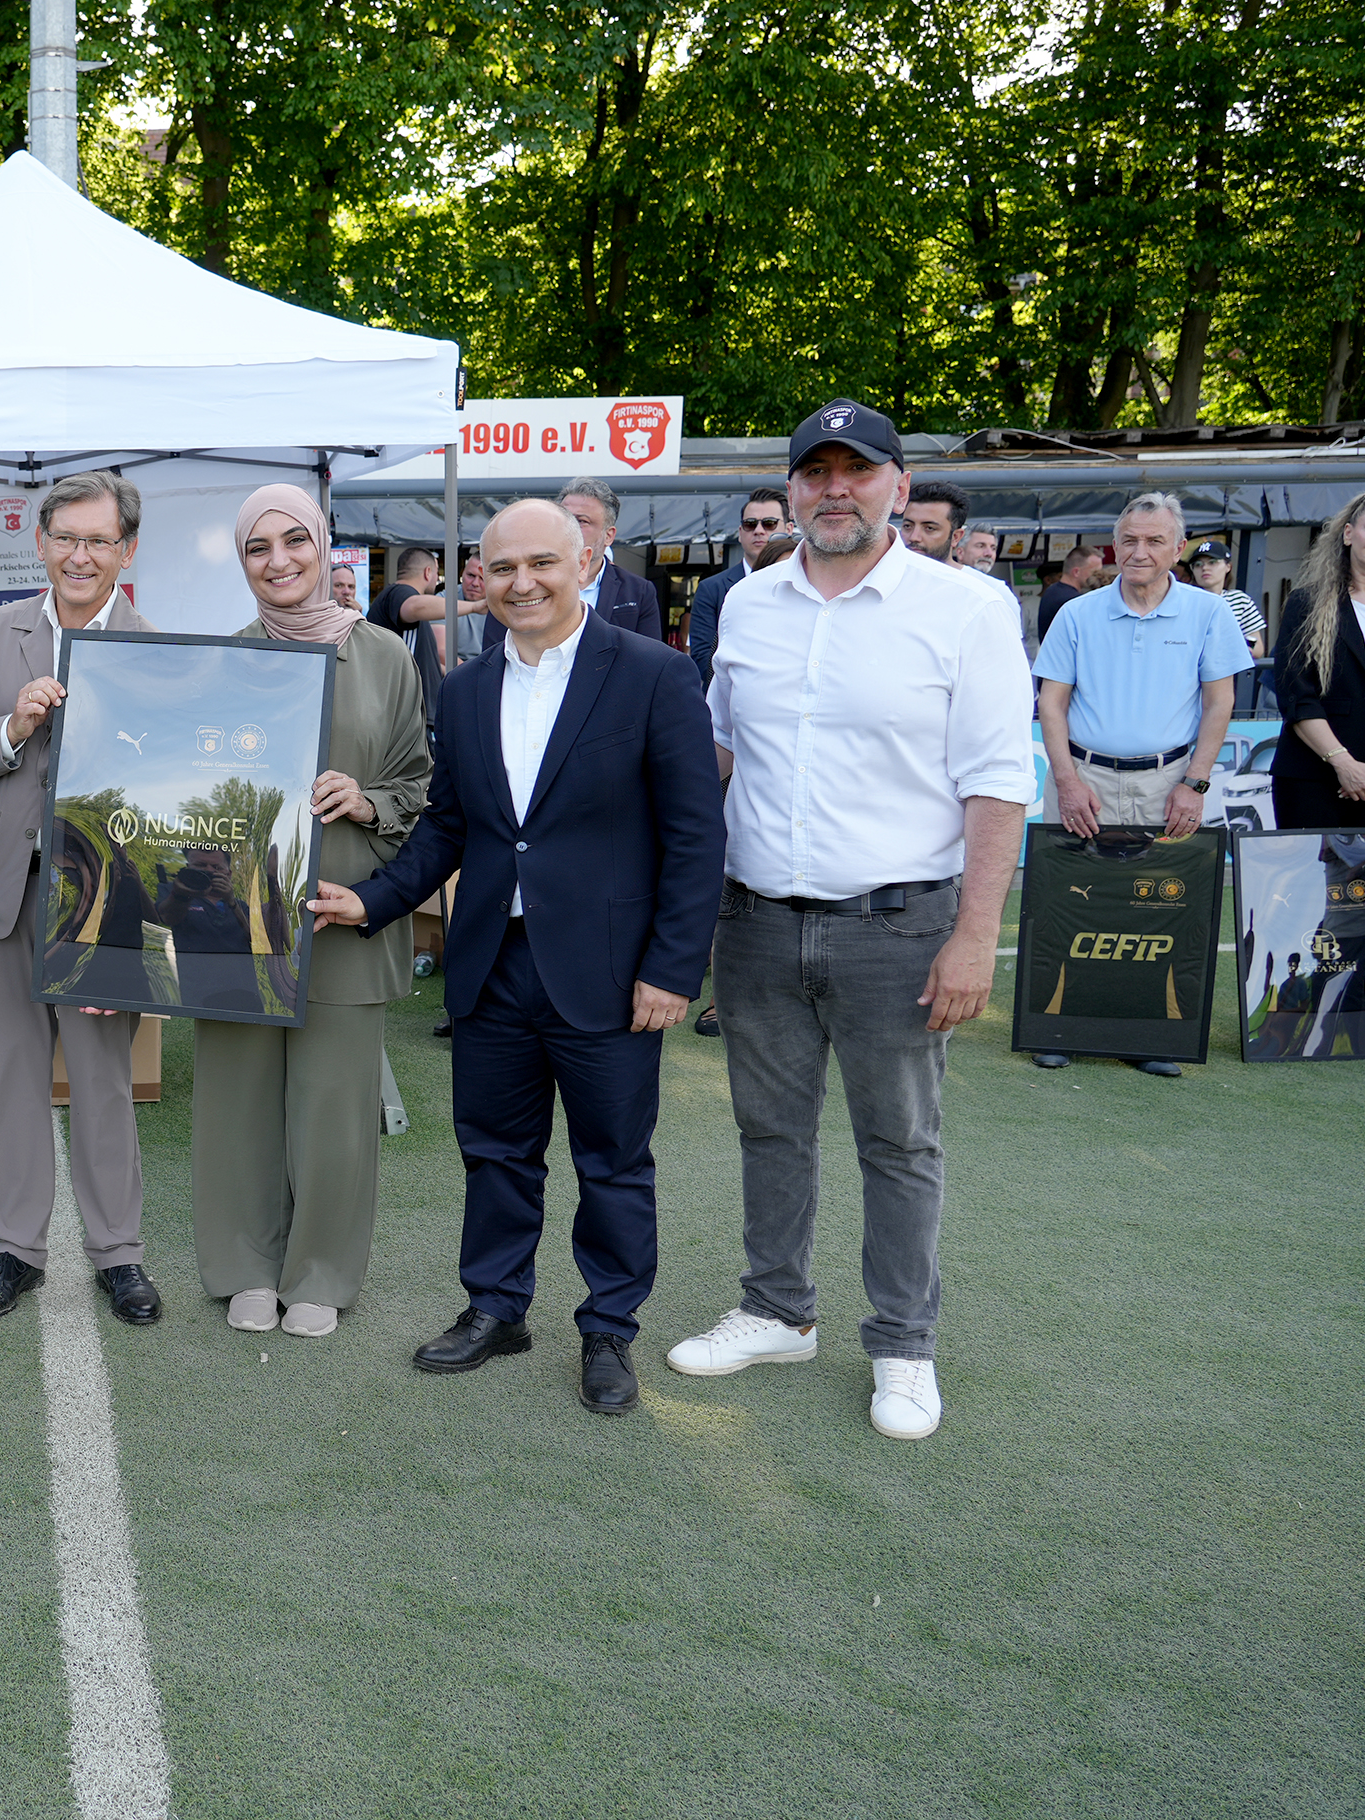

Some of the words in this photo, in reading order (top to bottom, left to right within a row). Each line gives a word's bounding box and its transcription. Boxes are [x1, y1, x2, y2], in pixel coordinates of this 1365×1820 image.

[457, 371, 466, 407] TOOLPORT
[613, 405, 665, 421] FIRTINASPOR
[618, 417, 635, 428] e.V.
[637, 417, 659, 428] 1990
[459, 422, 530, 454] 1990
[541, 421, 595, 453] e.V.
[32, 575, 47, 583] Mai
[200, 760, 214, 768] Jahre
[145, 811, 248, 841] NUANCE
[143, 835, 219, 851] Humanitarian
[221, 842, 240, 853] e.V.
